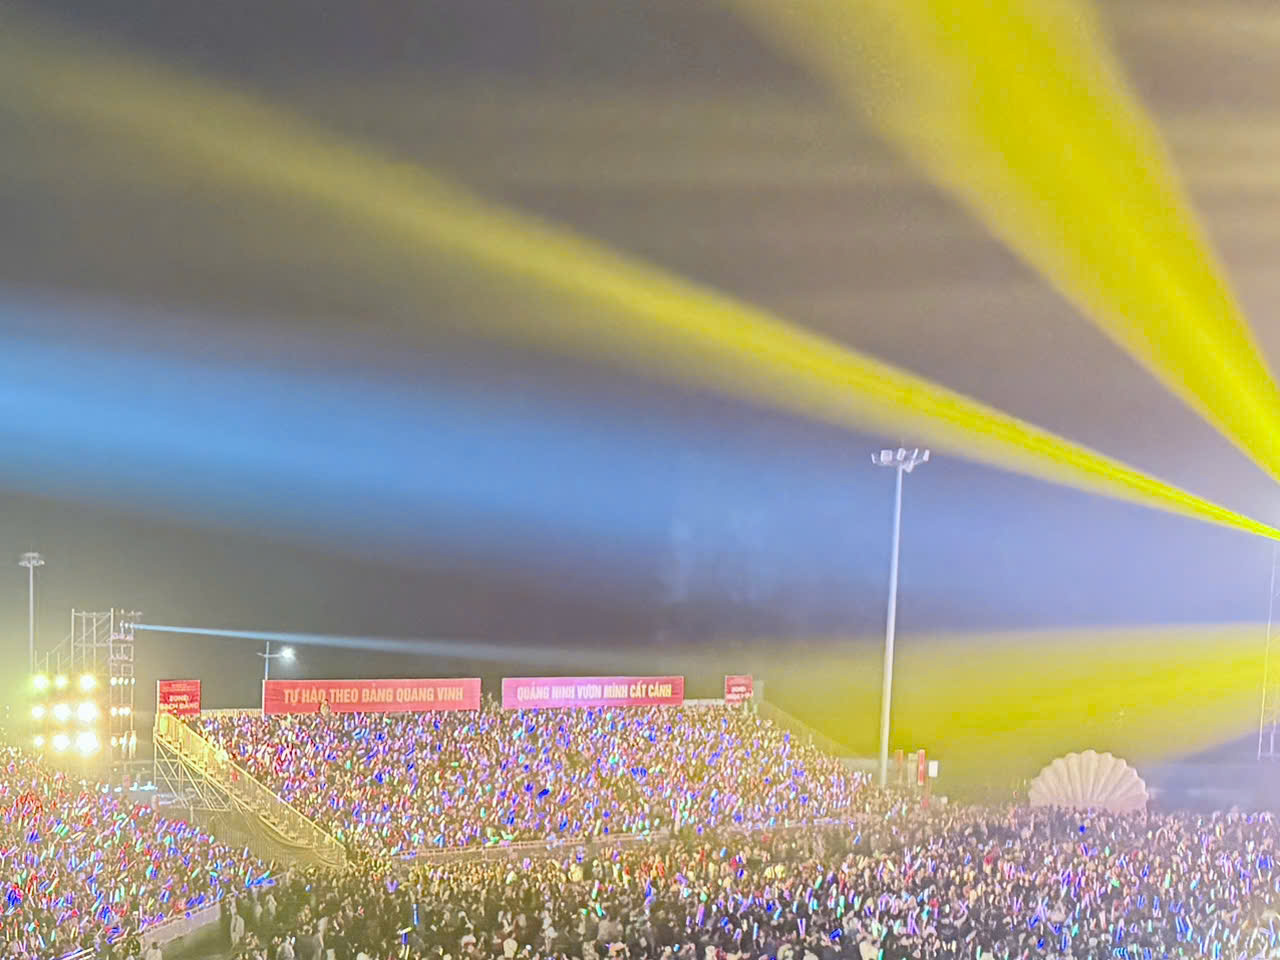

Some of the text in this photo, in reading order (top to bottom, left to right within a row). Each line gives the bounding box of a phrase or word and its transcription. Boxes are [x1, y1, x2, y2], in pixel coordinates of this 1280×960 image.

[284, 687, 300, 706] TỰ
[301, 686, 326, 704] HÀO
[329, 687, 359, 704] THEO
[396, 687, 434, 703] QUANG
[437, 687, 464, 701] VINH
[648, 681, 672, 698] CÁNH
